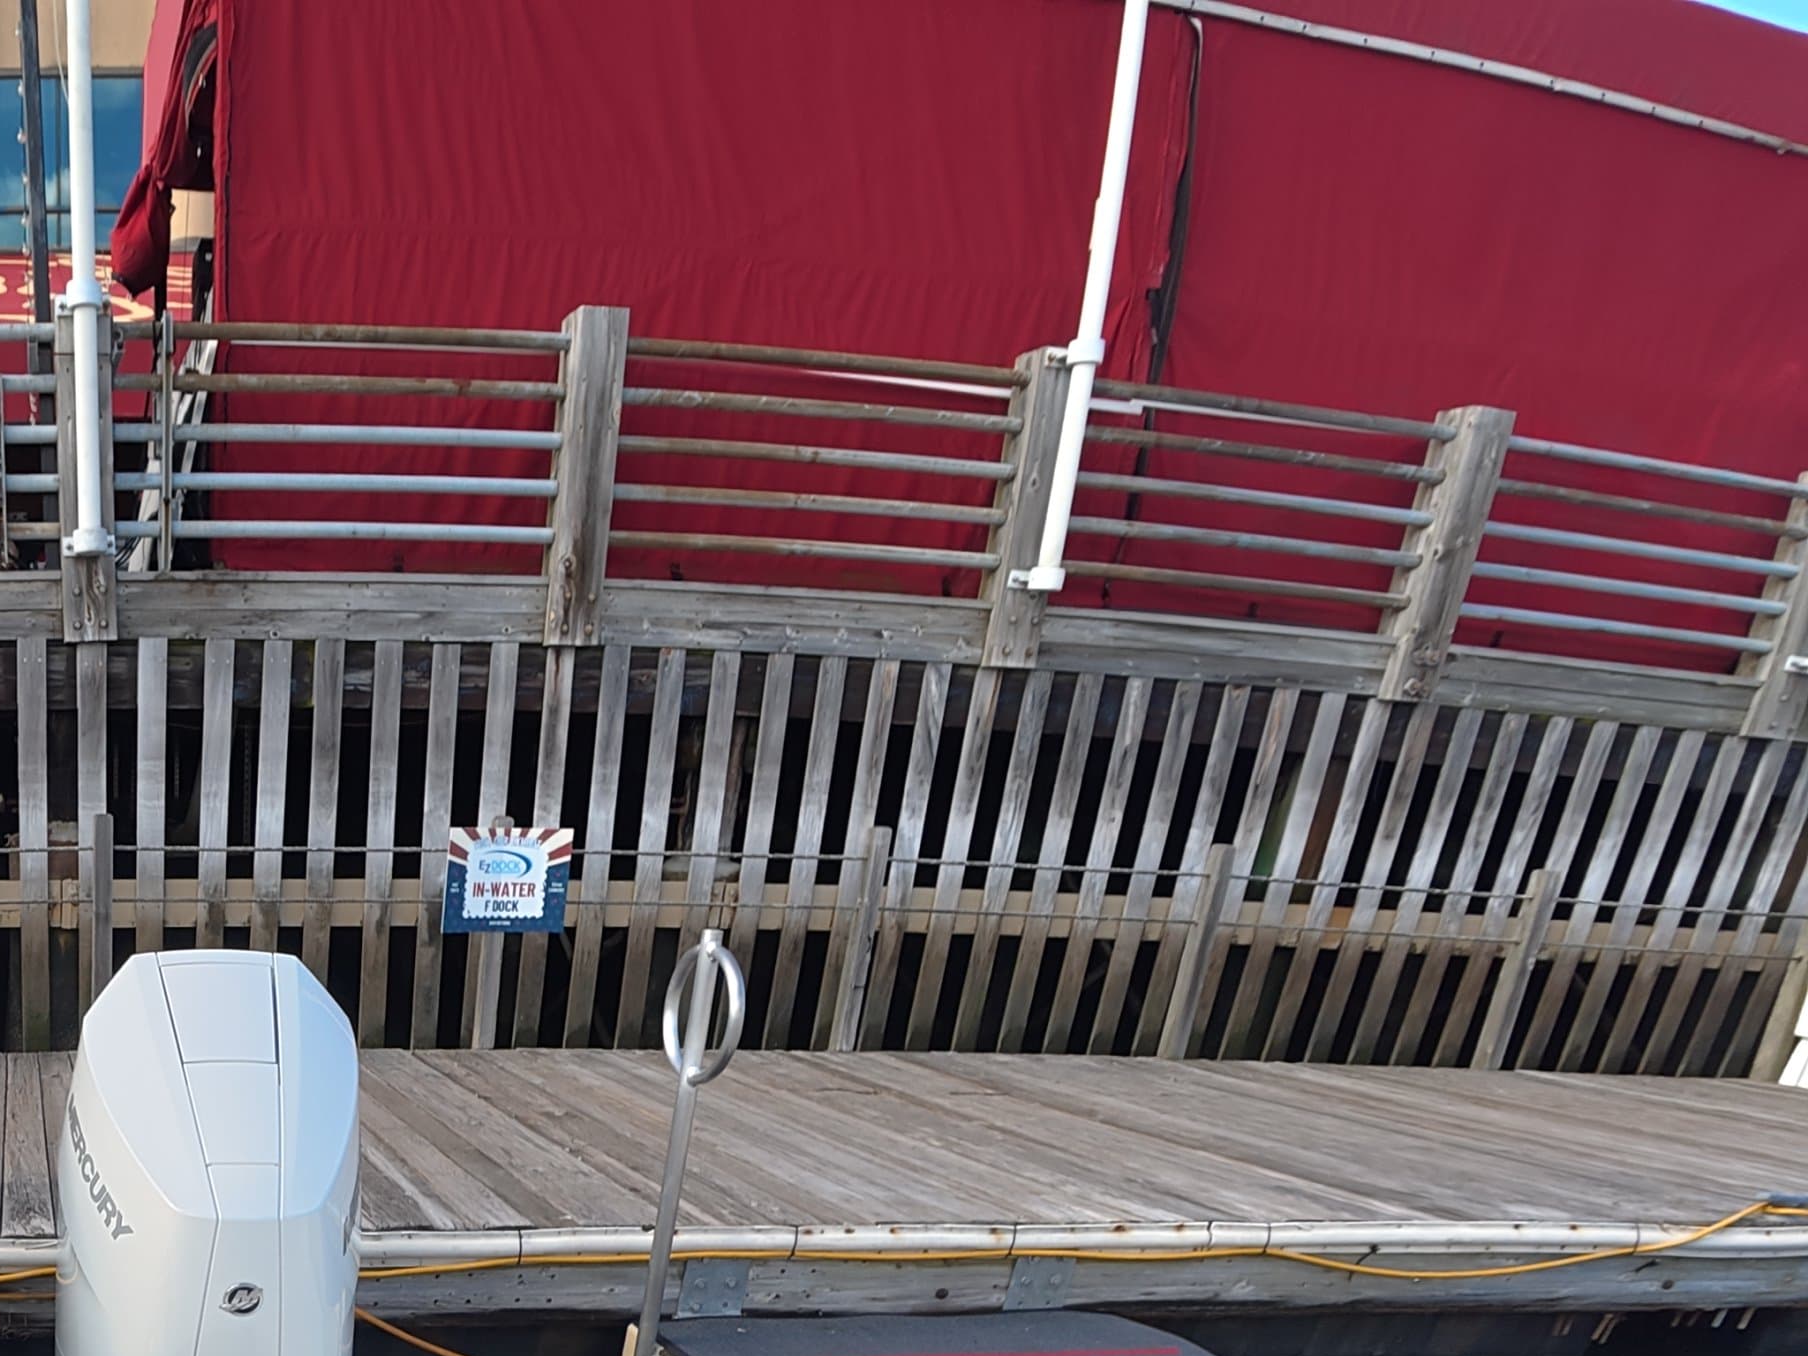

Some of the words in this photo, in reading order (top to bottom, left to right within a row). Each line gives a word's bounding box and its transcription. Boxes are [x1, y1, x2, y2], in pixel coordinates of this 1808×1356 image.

[473, 883, 536, 897] IN-WATER
[484, 900, 491, 912] F
[492, 899, 520, 912] DOCK
[68, 1093, 134, 1241] MERCURY
